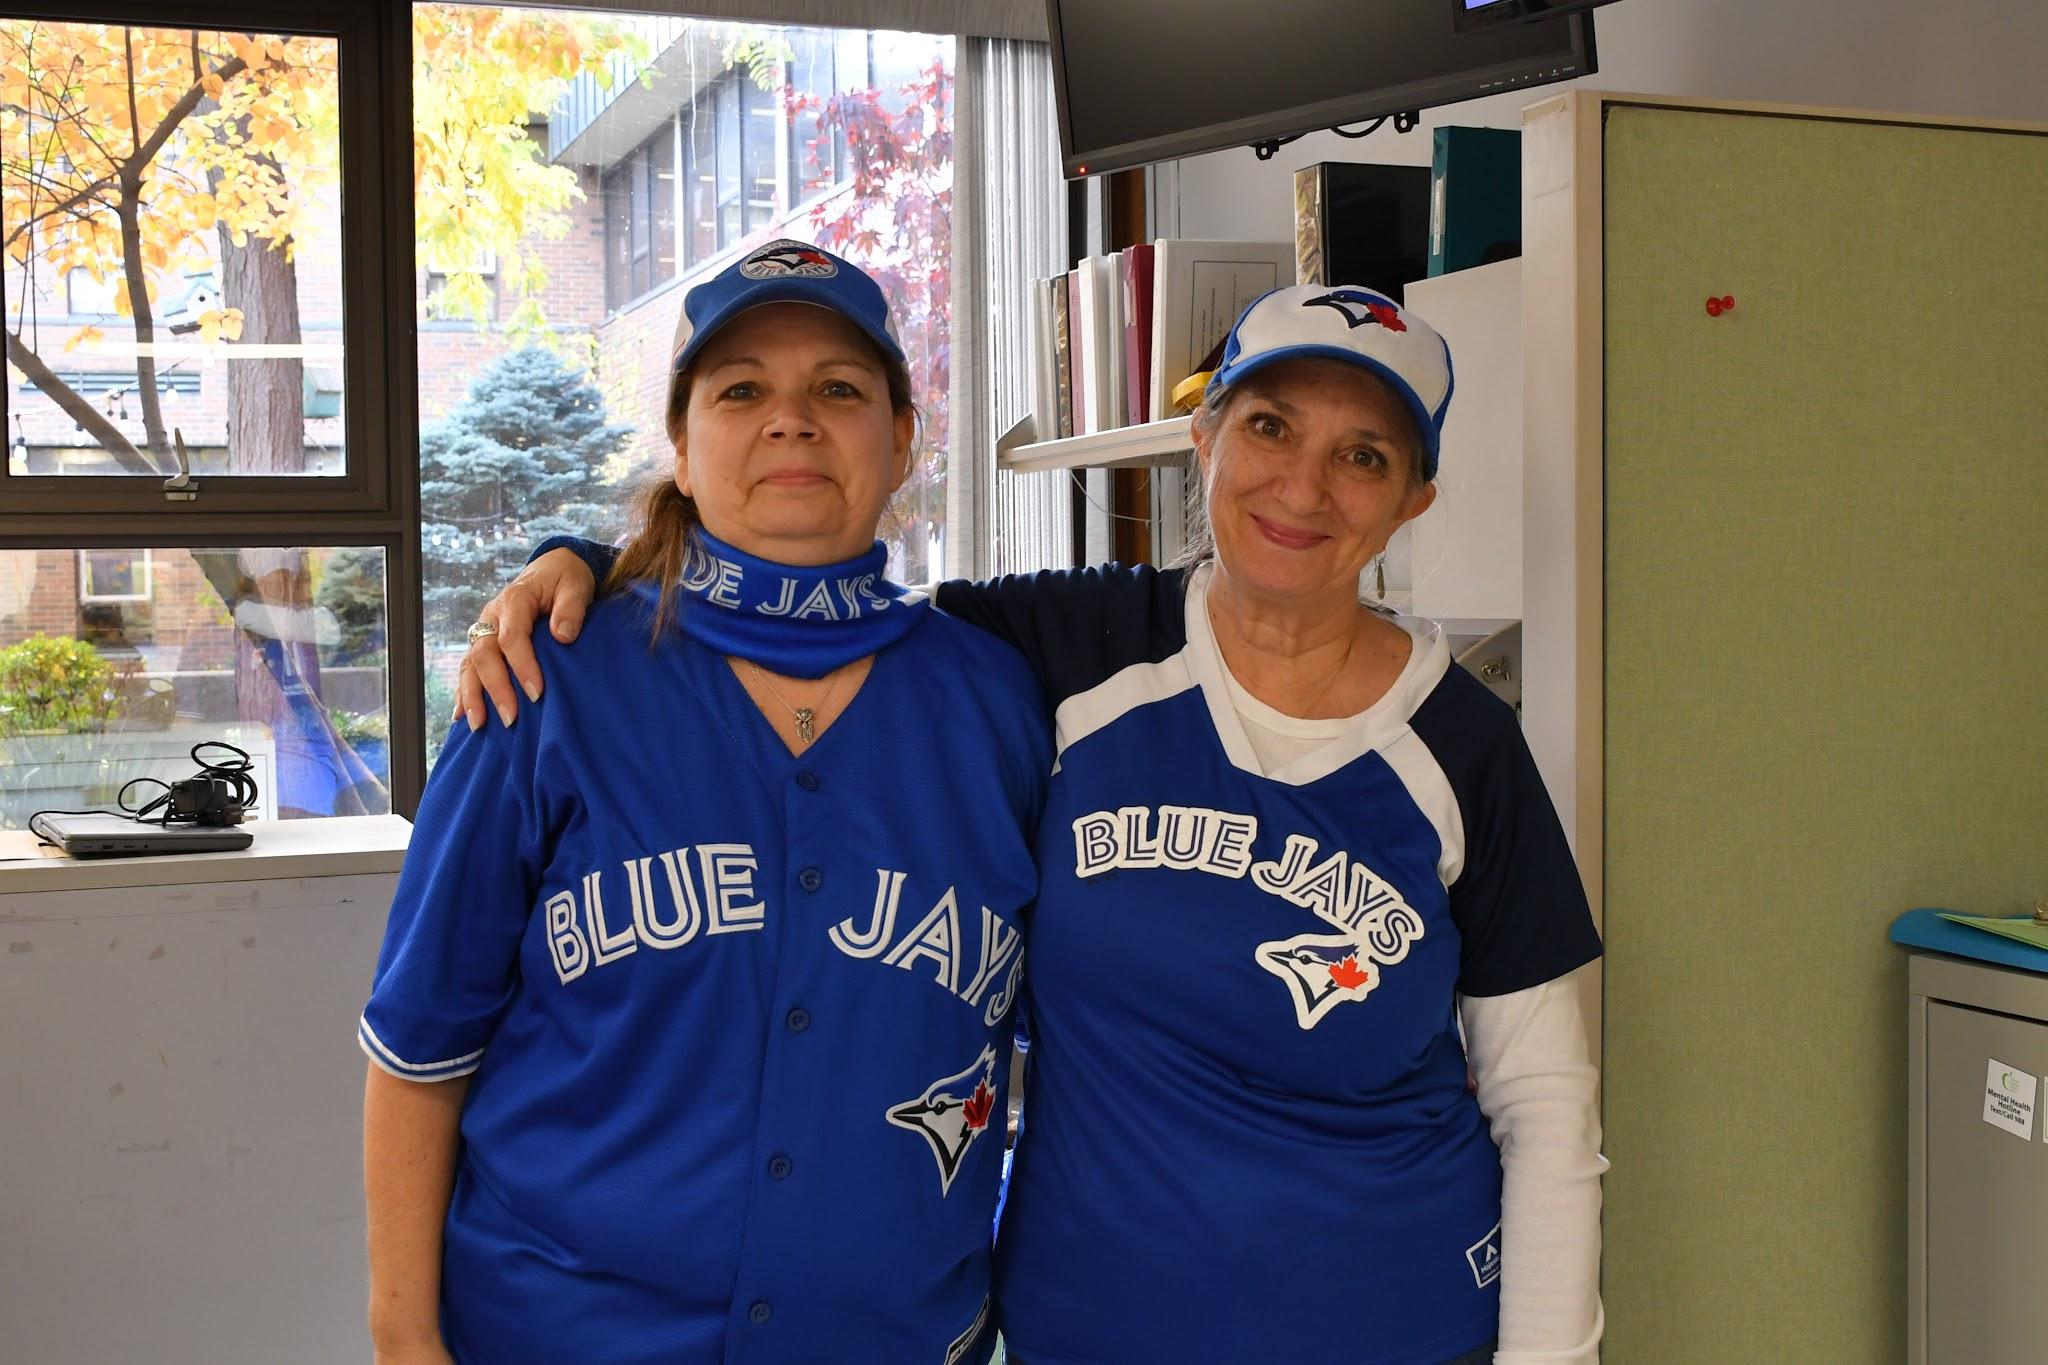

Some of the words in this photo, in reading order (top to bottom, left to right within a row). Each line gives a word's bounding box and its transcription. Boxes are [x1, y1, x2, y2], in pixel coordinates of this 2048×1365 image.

[755, 572, 891, 621] JAYS
[1075, 807, 1256, 877] BLUE
[1253, 836, 1423, 962] JAYS
[544, 843, 766, 986] BLUE
[1987, 1088, 2009, 1103] Mental
[2010, 1097, 2031, 1112] Health
[1990, 1105, 2014, 1120] Text/Call
[1998, 1101, 2021, 1116] Hotline
